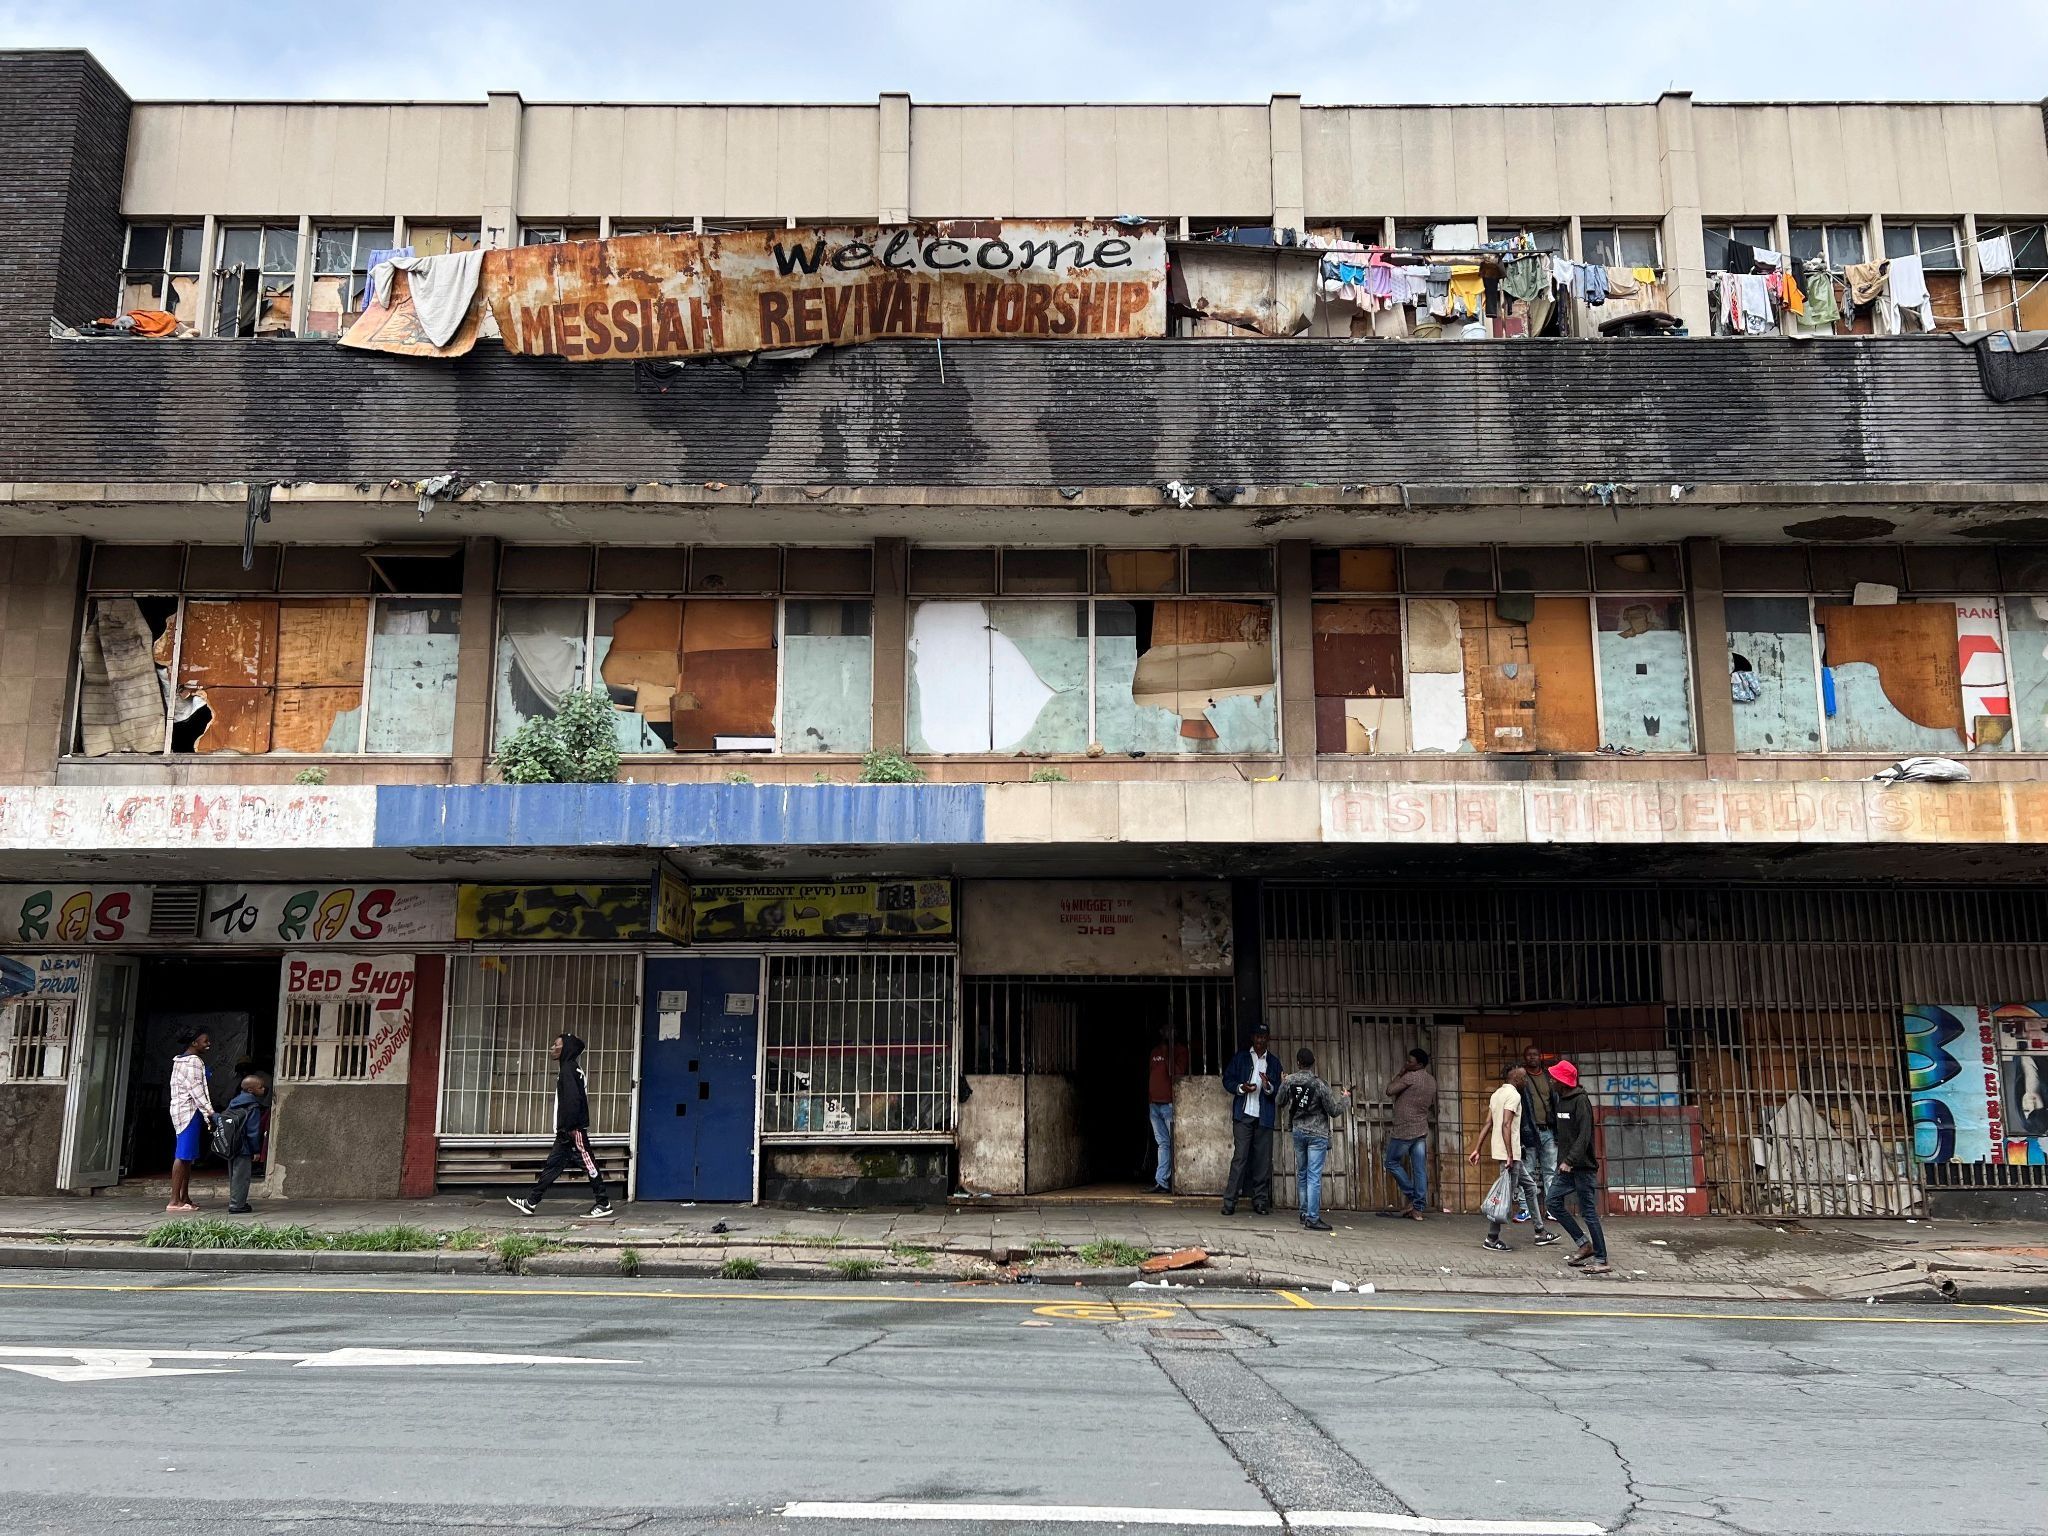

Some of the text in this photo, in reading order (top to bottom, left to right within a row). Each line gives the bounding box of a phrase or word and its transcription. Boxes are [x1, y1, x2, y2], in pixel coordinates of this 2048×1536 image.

[773, 229, 1133, 276] welcome
[520, 281, 1149, 356] MESSIAH REVIVAL WORSHIP
[1331, 792, 1498, 833] ASIA
[701, 887, 795, 897] INVESTMENT
[800, 886, 836, 897] (PVT)
[840, 885, 867, 895] LTD
[1072, 898, 1113, 911] NUGGET
[18, 889, 131, 942] RAS
[278, 888, 396, 941] RAS
[1060, 914, 1133, 923] EXPRESS BUILDING
[1078, 926, 1115, 935] JHB
[368, 1023, 394, 1059] NEW
[369, 1008, 412, 1080] PRODUCTION
[1619, 1194, 1685, 1212] SPECIAL
